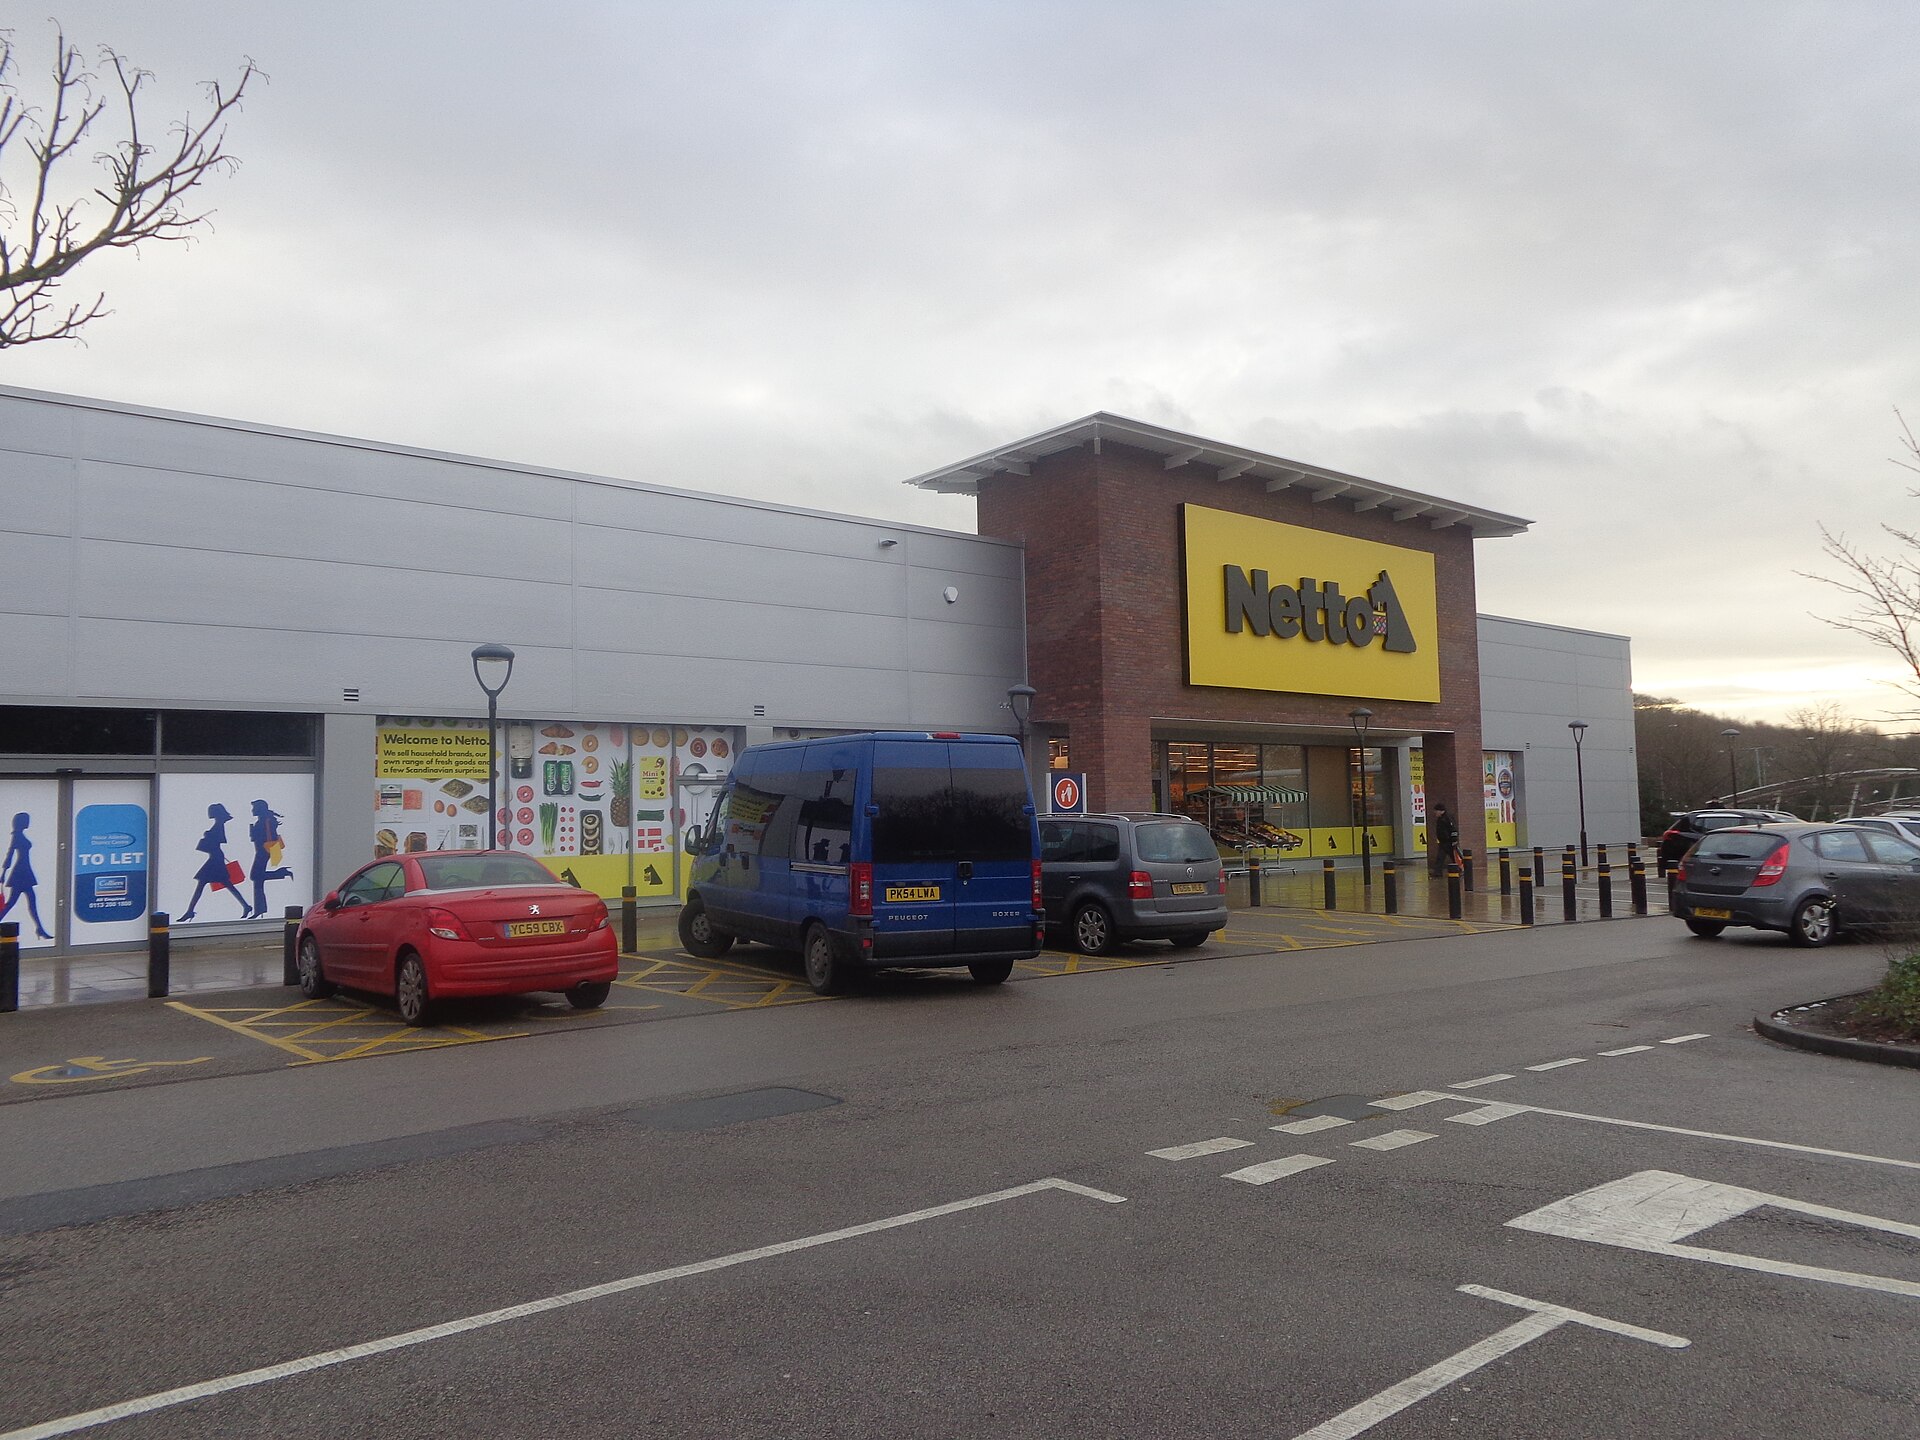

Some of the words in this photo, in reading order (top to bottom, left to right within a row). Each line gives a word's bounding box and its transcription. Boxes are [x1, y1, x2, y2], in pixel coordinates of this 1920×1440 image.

[1223, 564, 1375, 647] Netto
[384, 734, 438, 745] Welcome
[441, 736, 452, 745] to
[455, 735, 490, 746] Netto.
[454, 758, 476, 767] goods
[454, 767, 487, 776] surprises.
[79, 853, 105, 866] TO
[110, 852, 144, 865] LET
[890, 888, 915, 899] PK54
[917, 888, 936, 899] LWA
[511, 923, 540, 935] YC59
[541, 922, 562, 933] CBX
